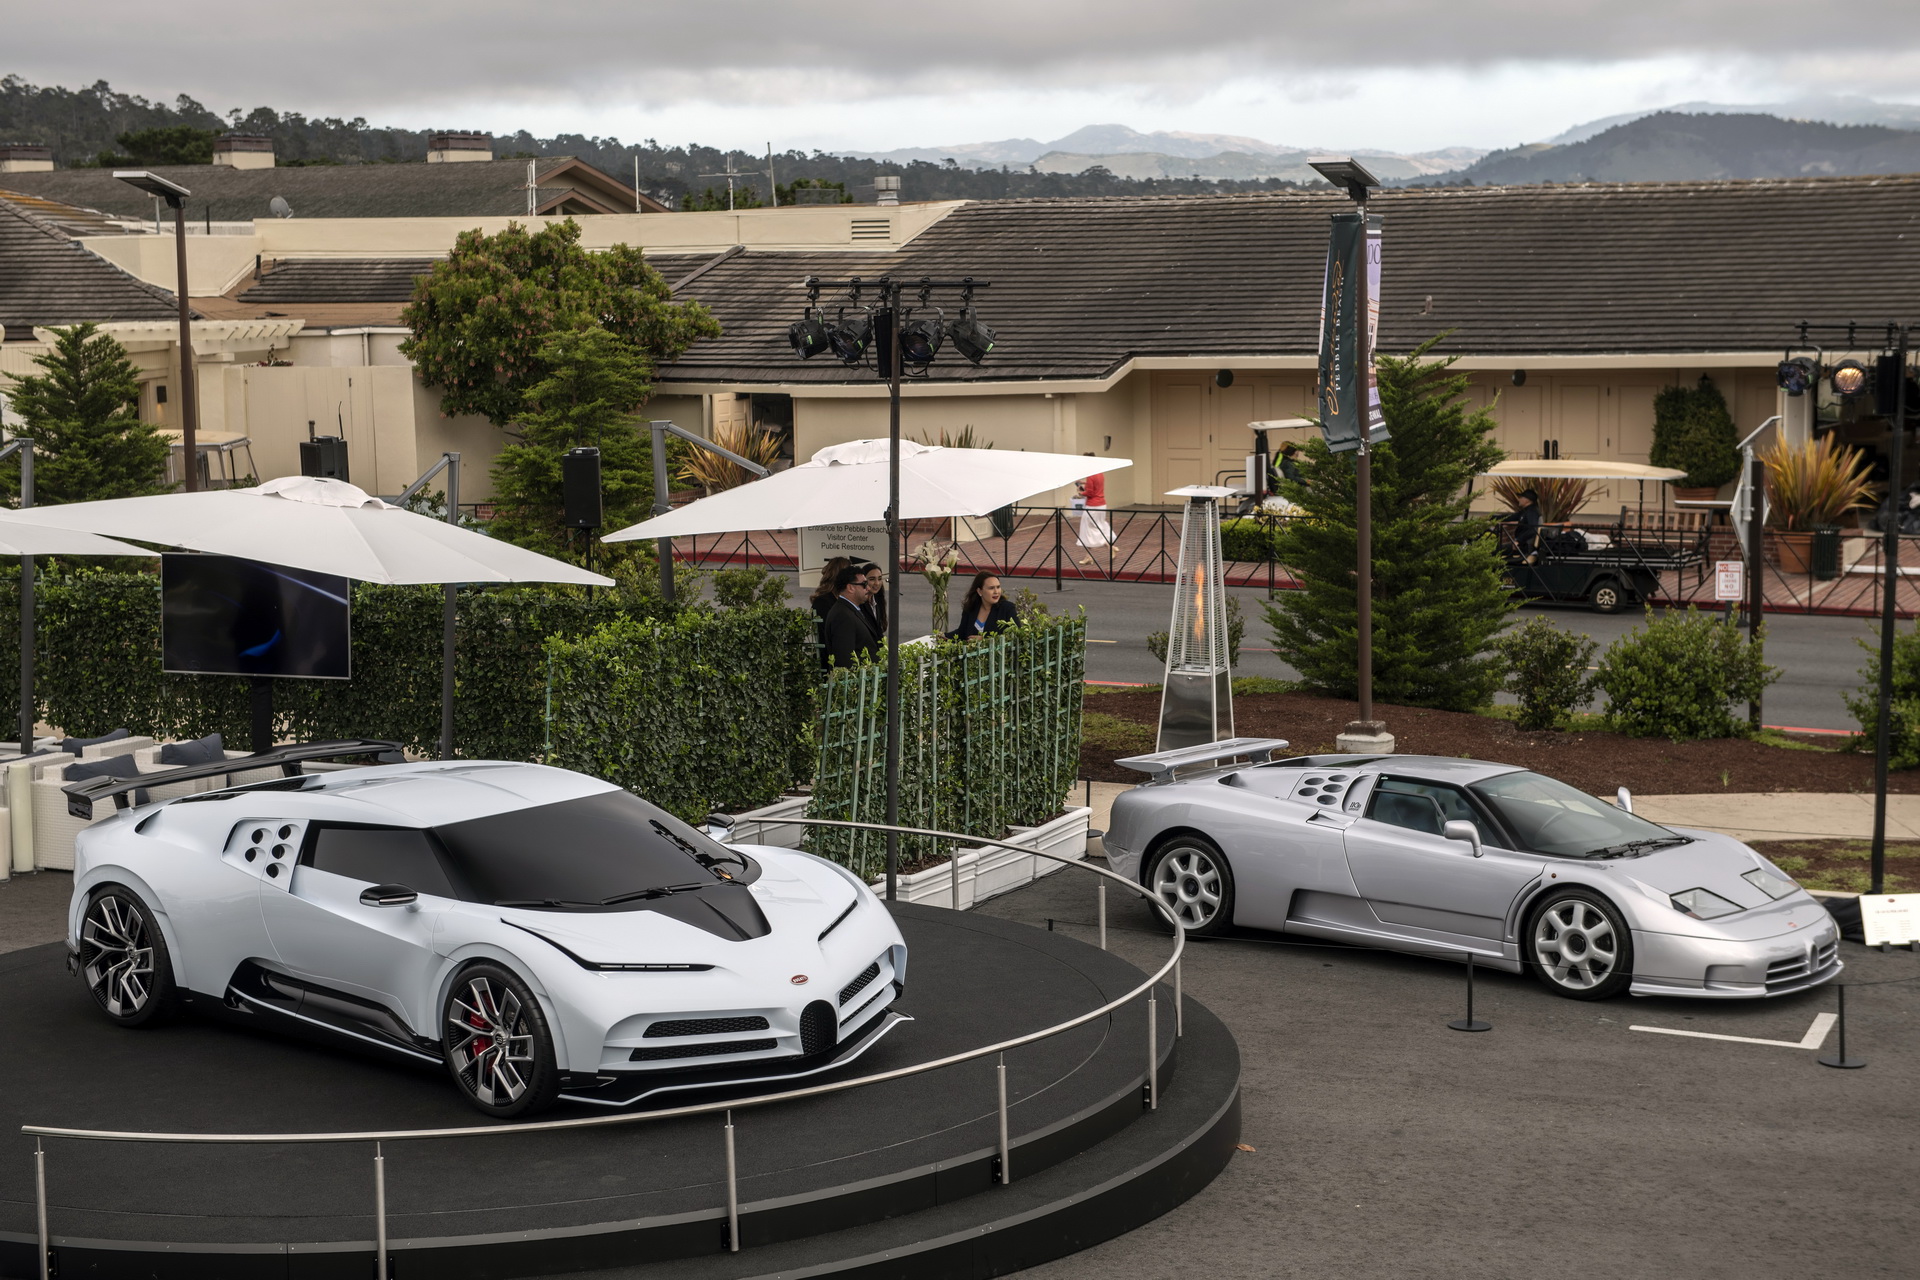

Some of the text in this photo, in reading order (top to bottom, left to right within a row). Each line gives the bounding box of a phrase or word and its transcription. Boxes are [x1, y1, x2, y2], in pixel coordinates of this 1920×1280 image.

[844, 525, 865, 533] Pebble
[867, 525, 887, 533] Beach
[847, 534, 869, 542] Center
[821, 542, 875, 551] Public Restrooms
